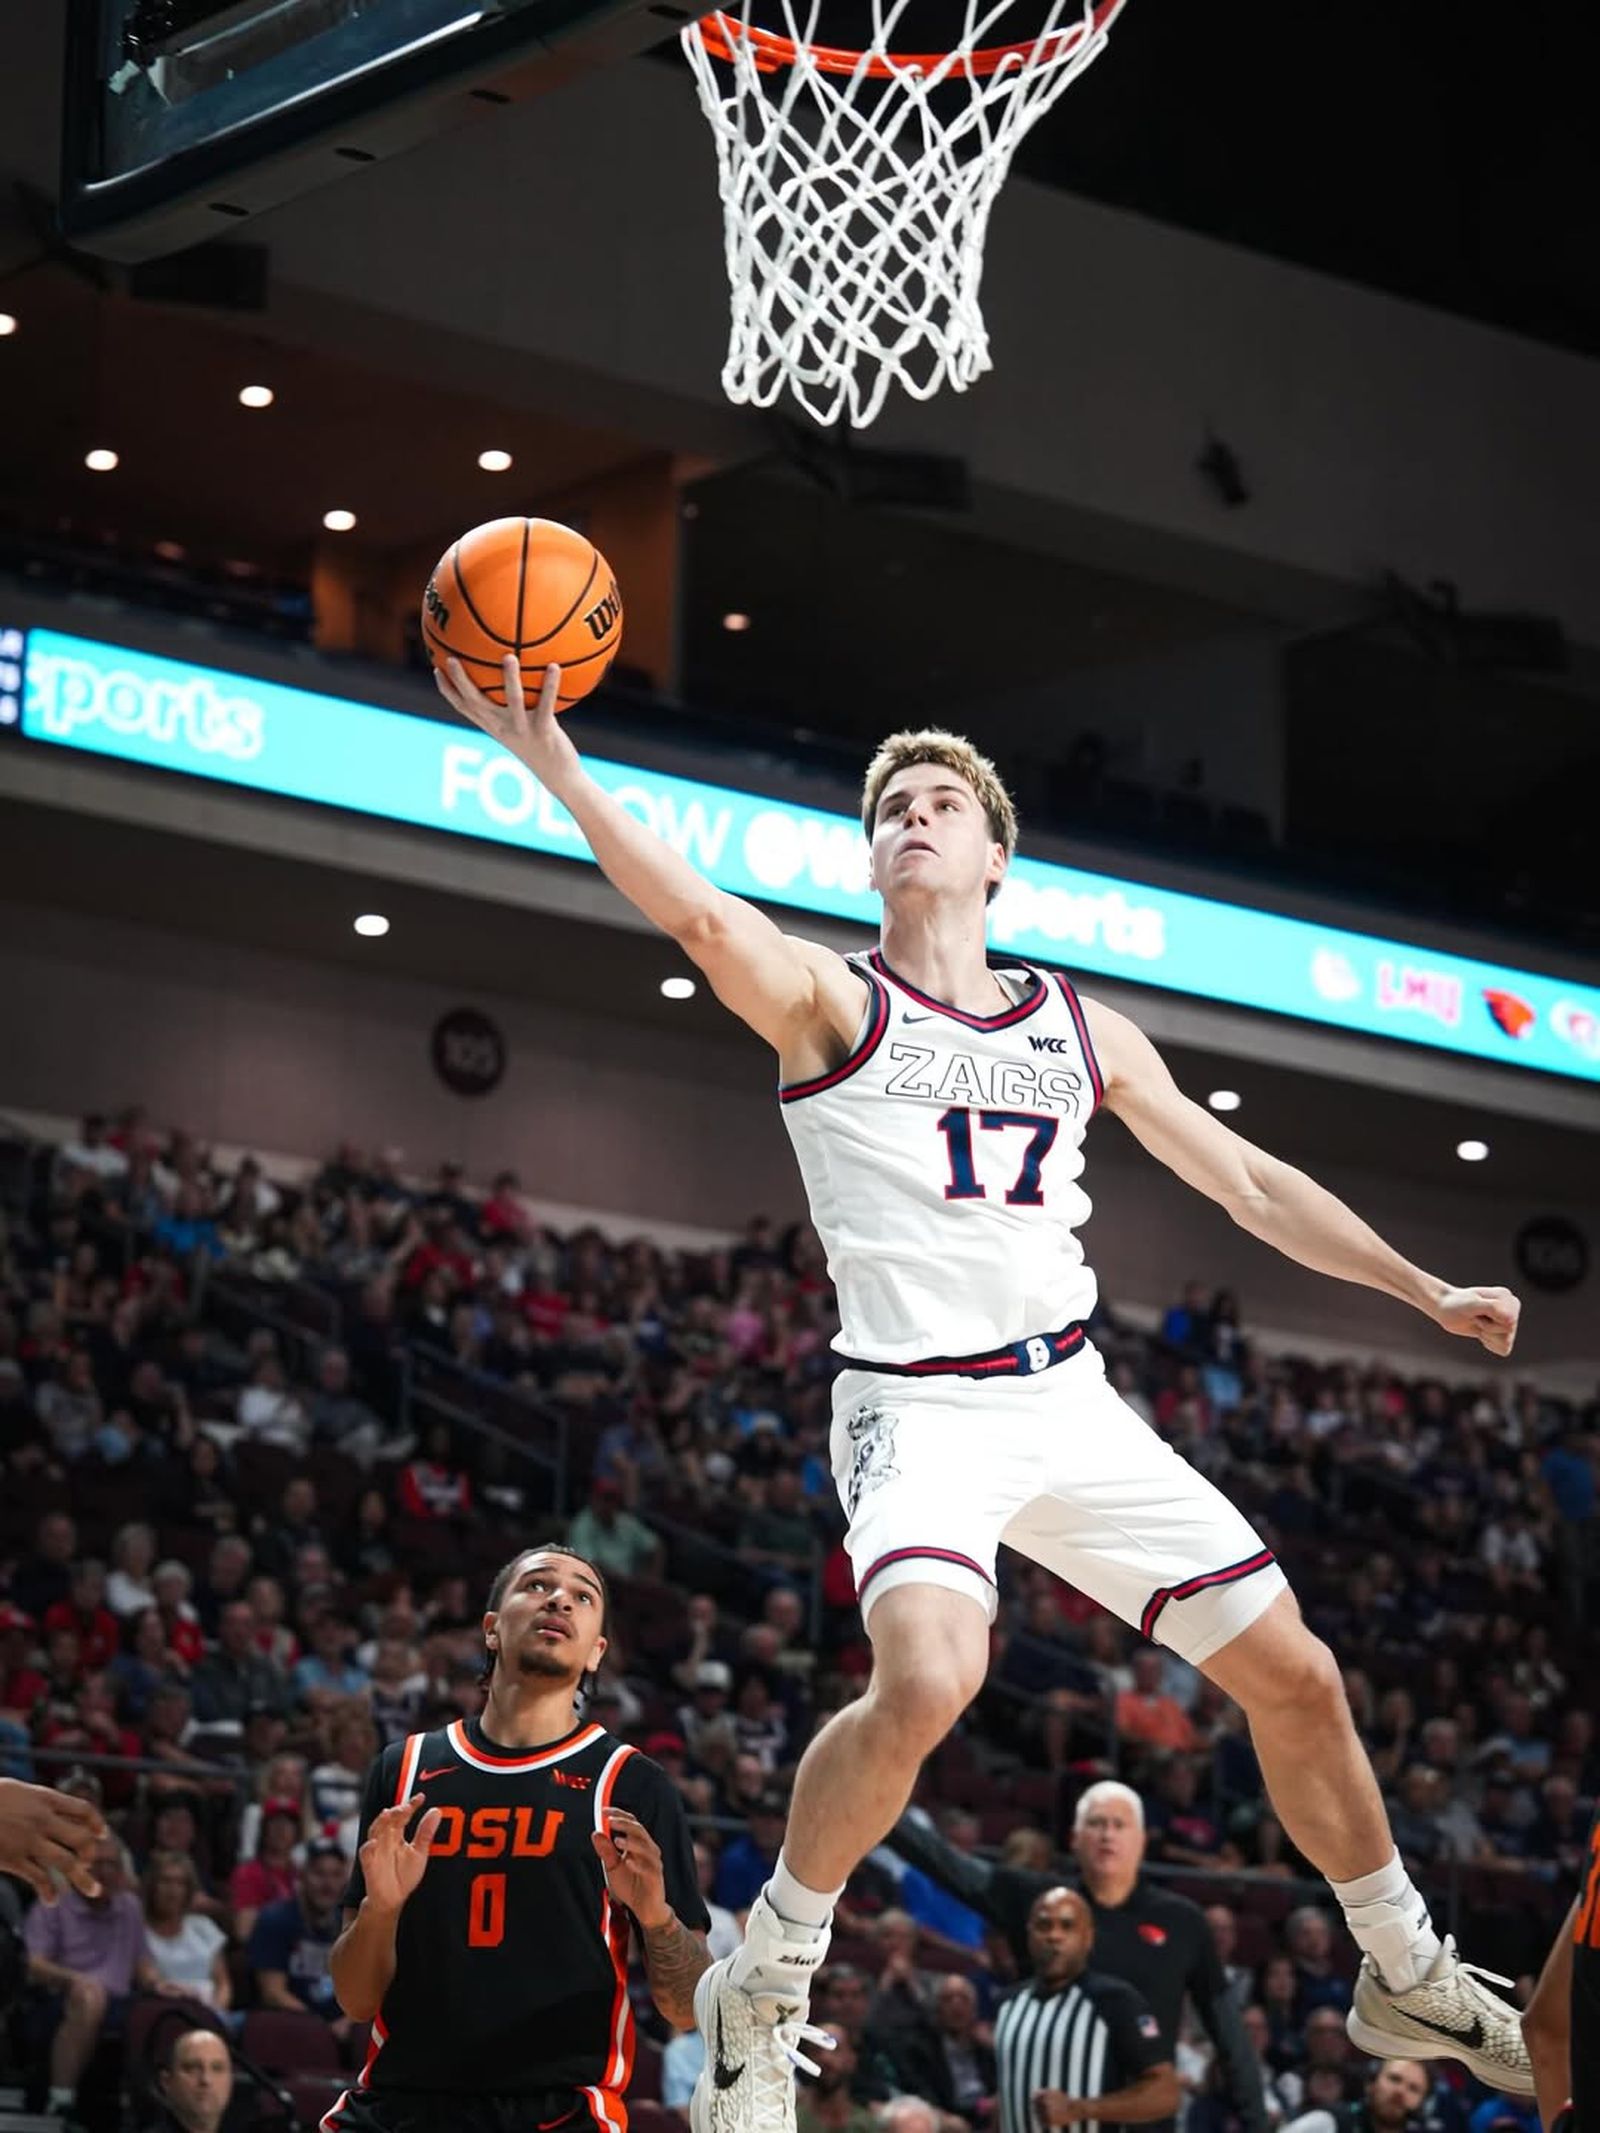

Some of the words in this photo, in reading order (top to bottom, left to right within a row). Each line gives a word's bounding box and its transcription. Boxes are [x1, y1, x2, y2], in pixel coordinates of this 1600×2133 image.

[441, 744, 733, 869] FOLOW
[885, 1042, 1081, 1119] ZAGS
[1028, 1036, 1067, 1054] WCC
[937, 1106, 1059, 1207] 17
[429, 1806, 565, 1859] OSU
[467, 1873, 507, 1948] 0
